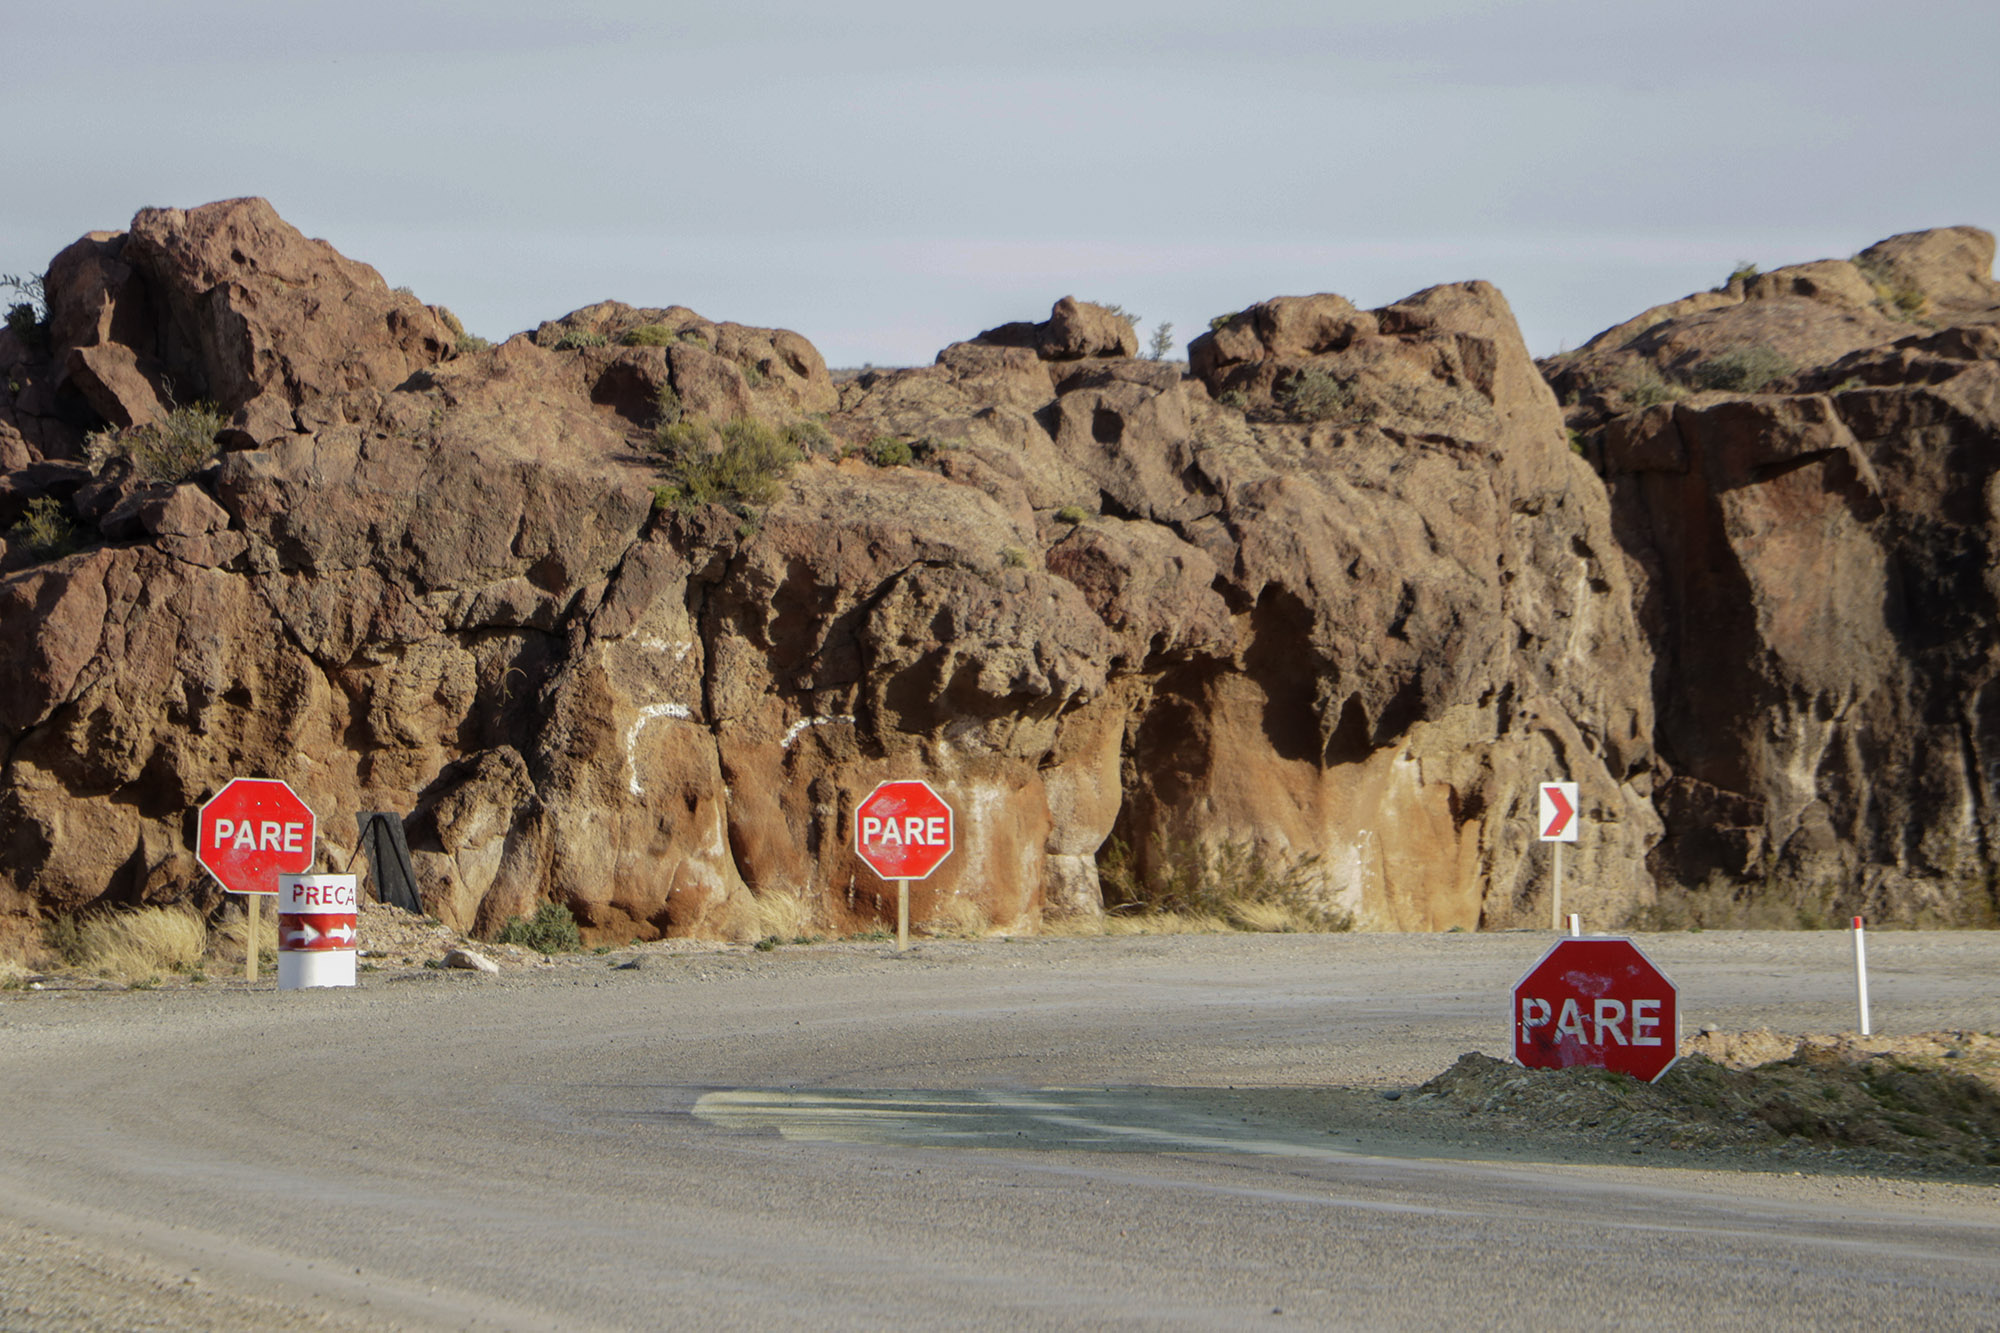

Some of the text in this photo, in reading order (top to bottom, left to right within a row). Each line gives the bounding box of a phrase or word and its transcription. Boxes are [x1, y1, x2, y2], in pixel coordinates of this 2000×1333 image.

[214, 818, 305, 852] PARE
[863, 816, 945, 845] PARE
[1522, 998, 1662, 1046] PARE
